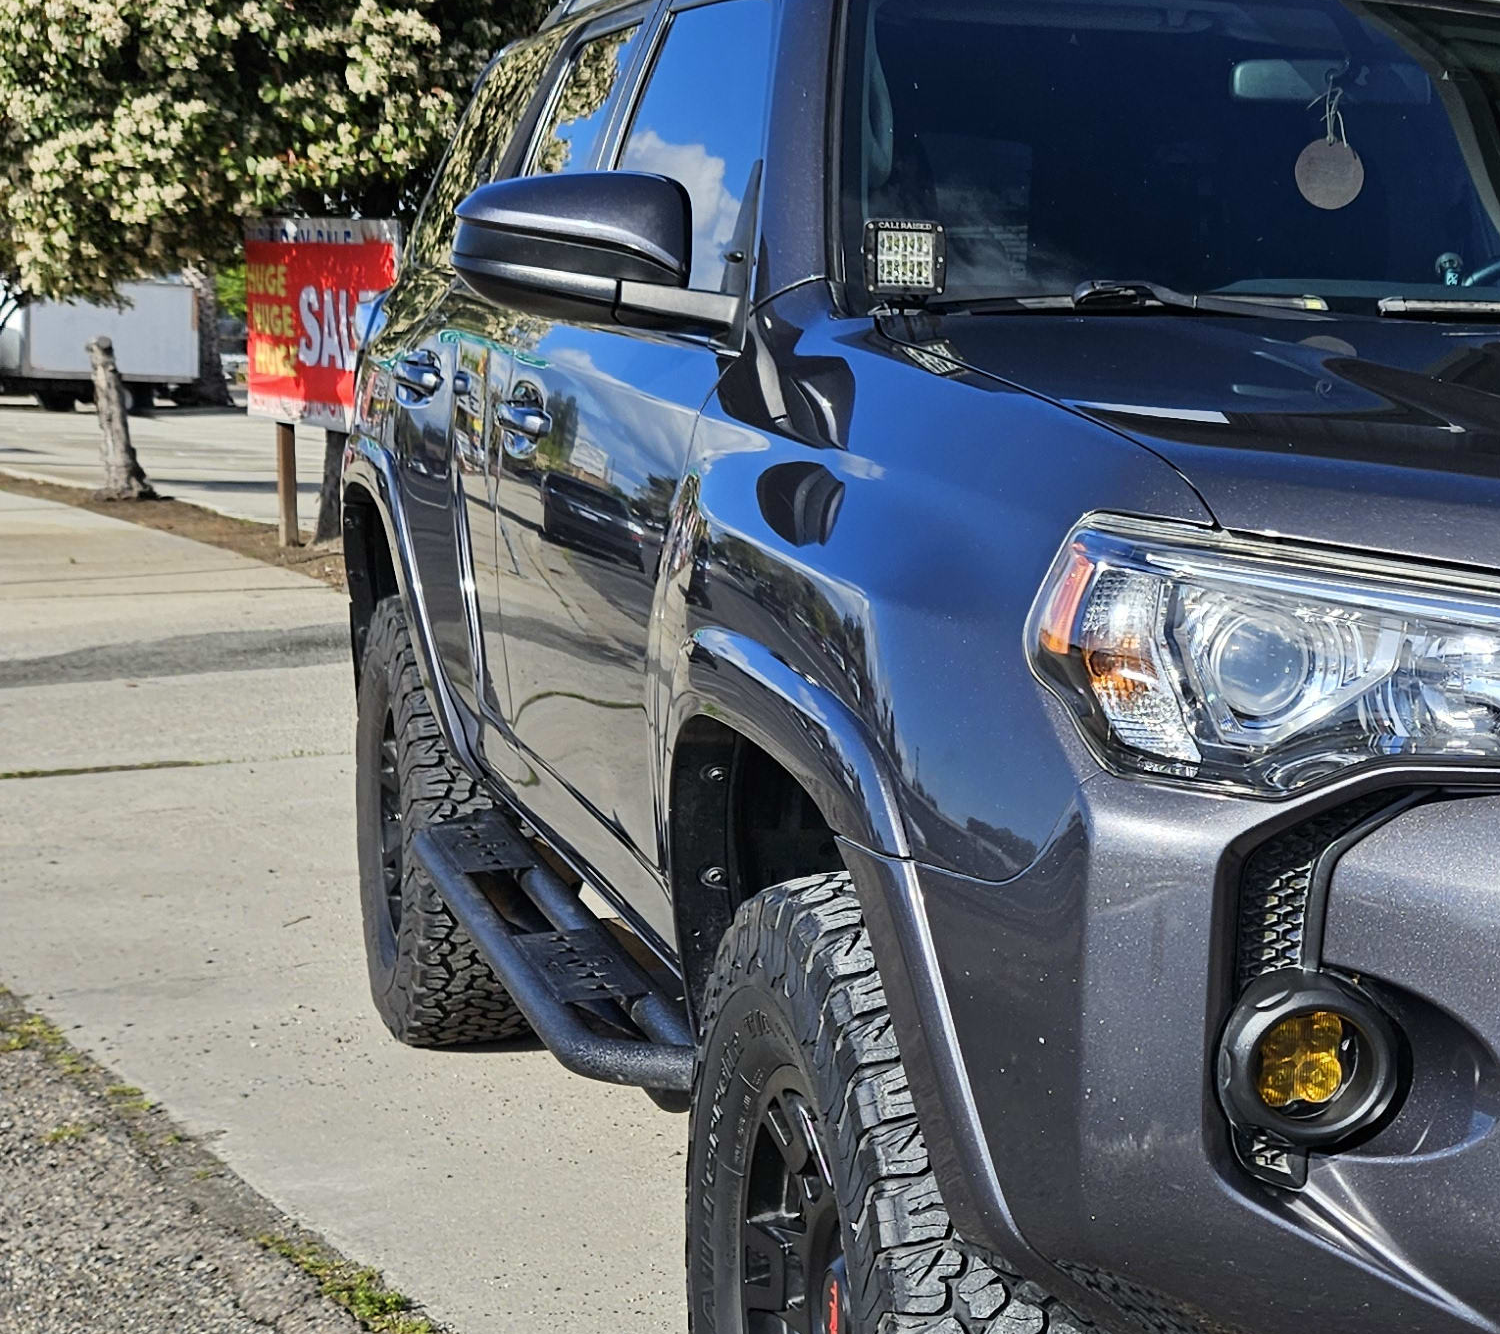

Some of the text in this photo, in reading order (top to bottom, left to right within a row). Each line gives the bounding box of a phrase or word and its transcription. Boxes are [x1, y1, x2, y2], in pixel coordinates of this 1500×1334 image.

[248, 263, 287, 298] HUGE
[252, 303, 295, 338] HUGE
[255, 339, 298, 378] HUGE
